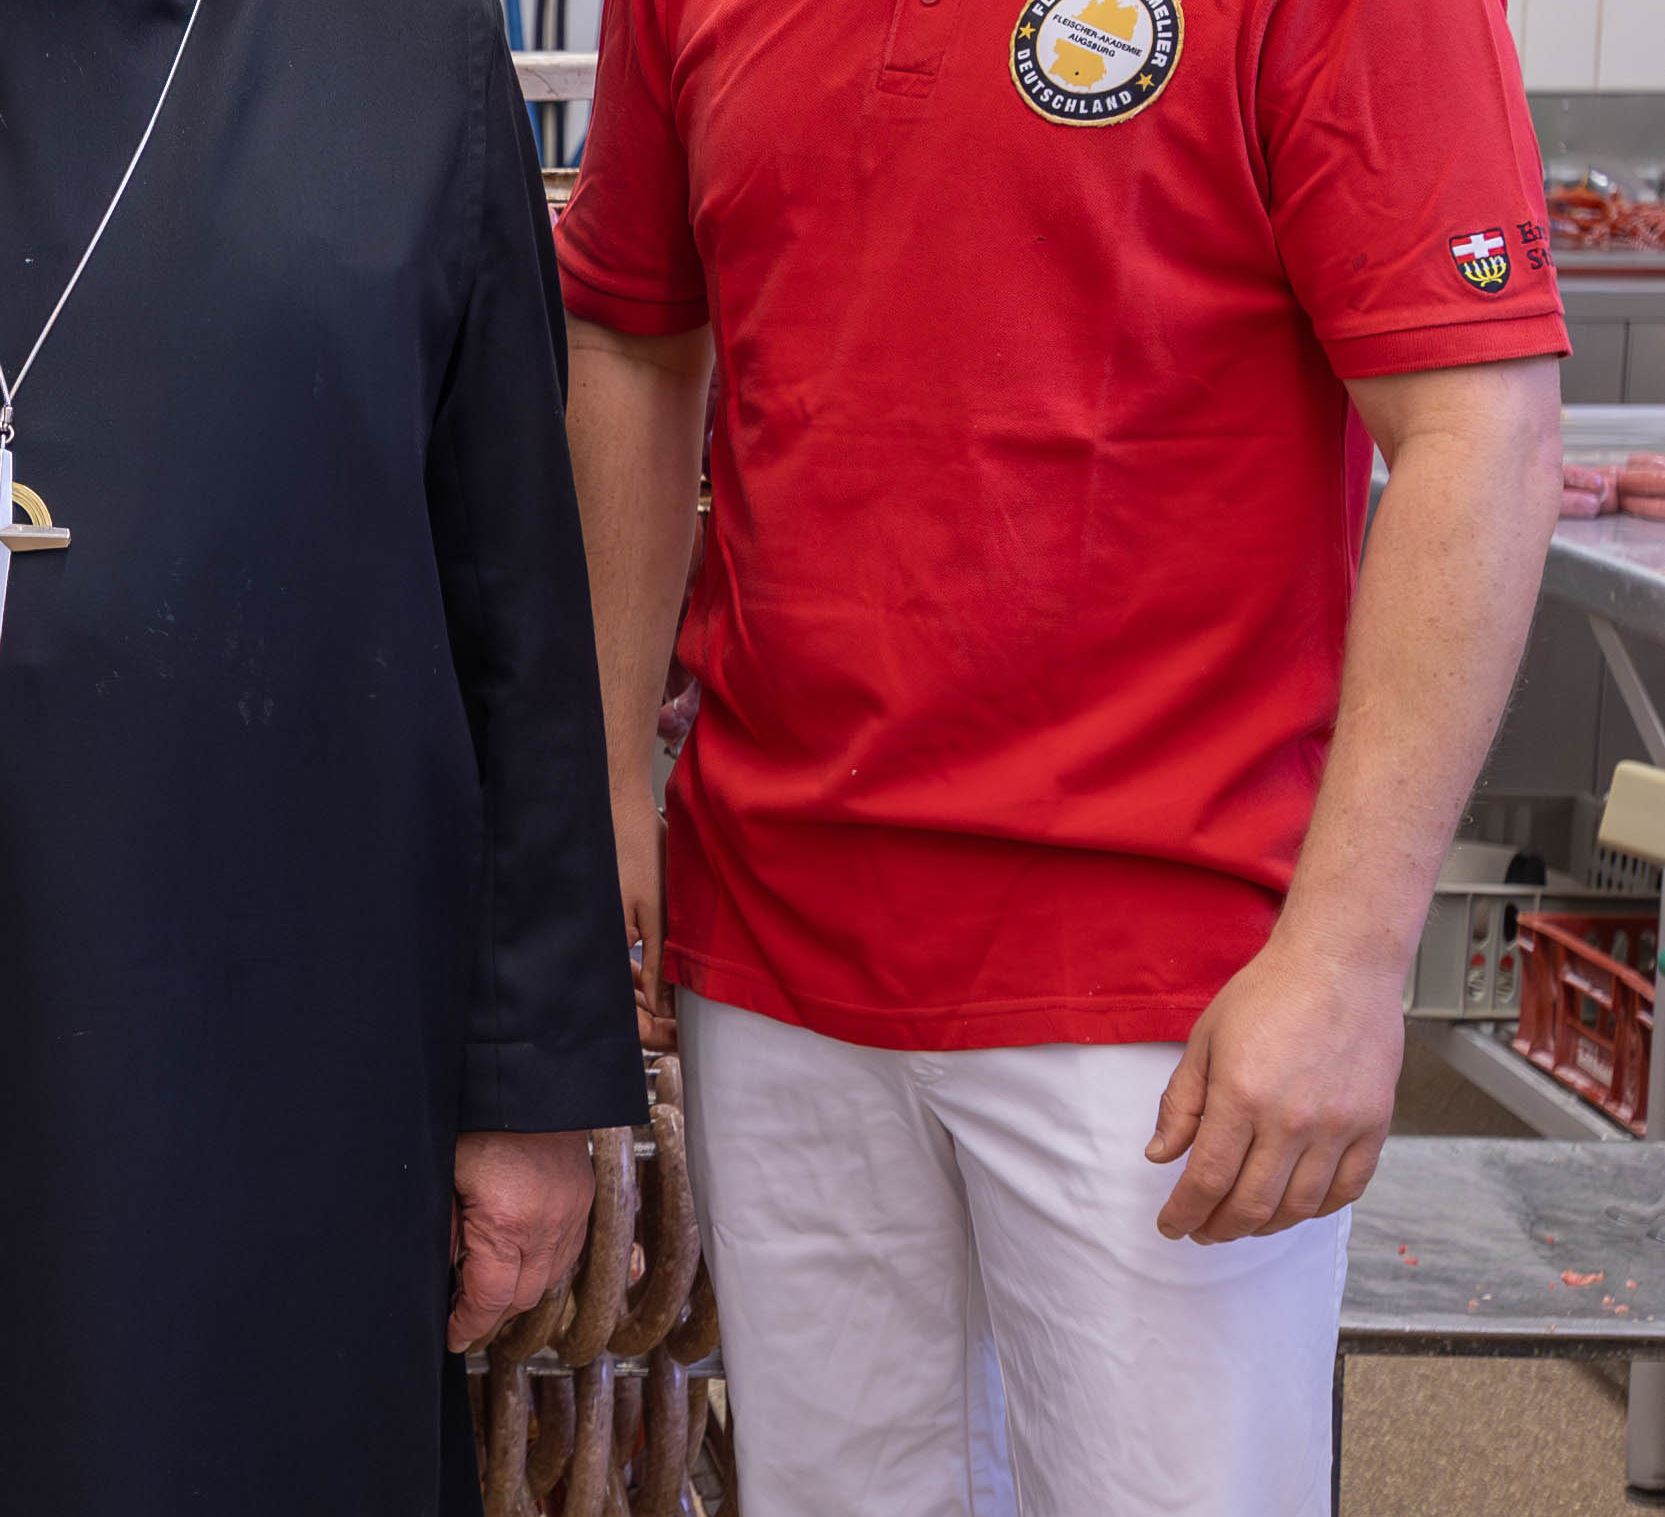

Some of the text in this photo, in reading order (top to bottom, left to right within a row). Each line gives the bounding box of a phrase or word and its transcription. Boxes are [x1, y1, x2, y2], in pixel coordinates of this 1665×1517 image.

[1052, 13, 1144, 57] FLEISCHER-AKADEMIE
[1067, 32, 1117, 58] AUGSBURG
[1016, 48, 1133, 114] DEUTSCHLAND
